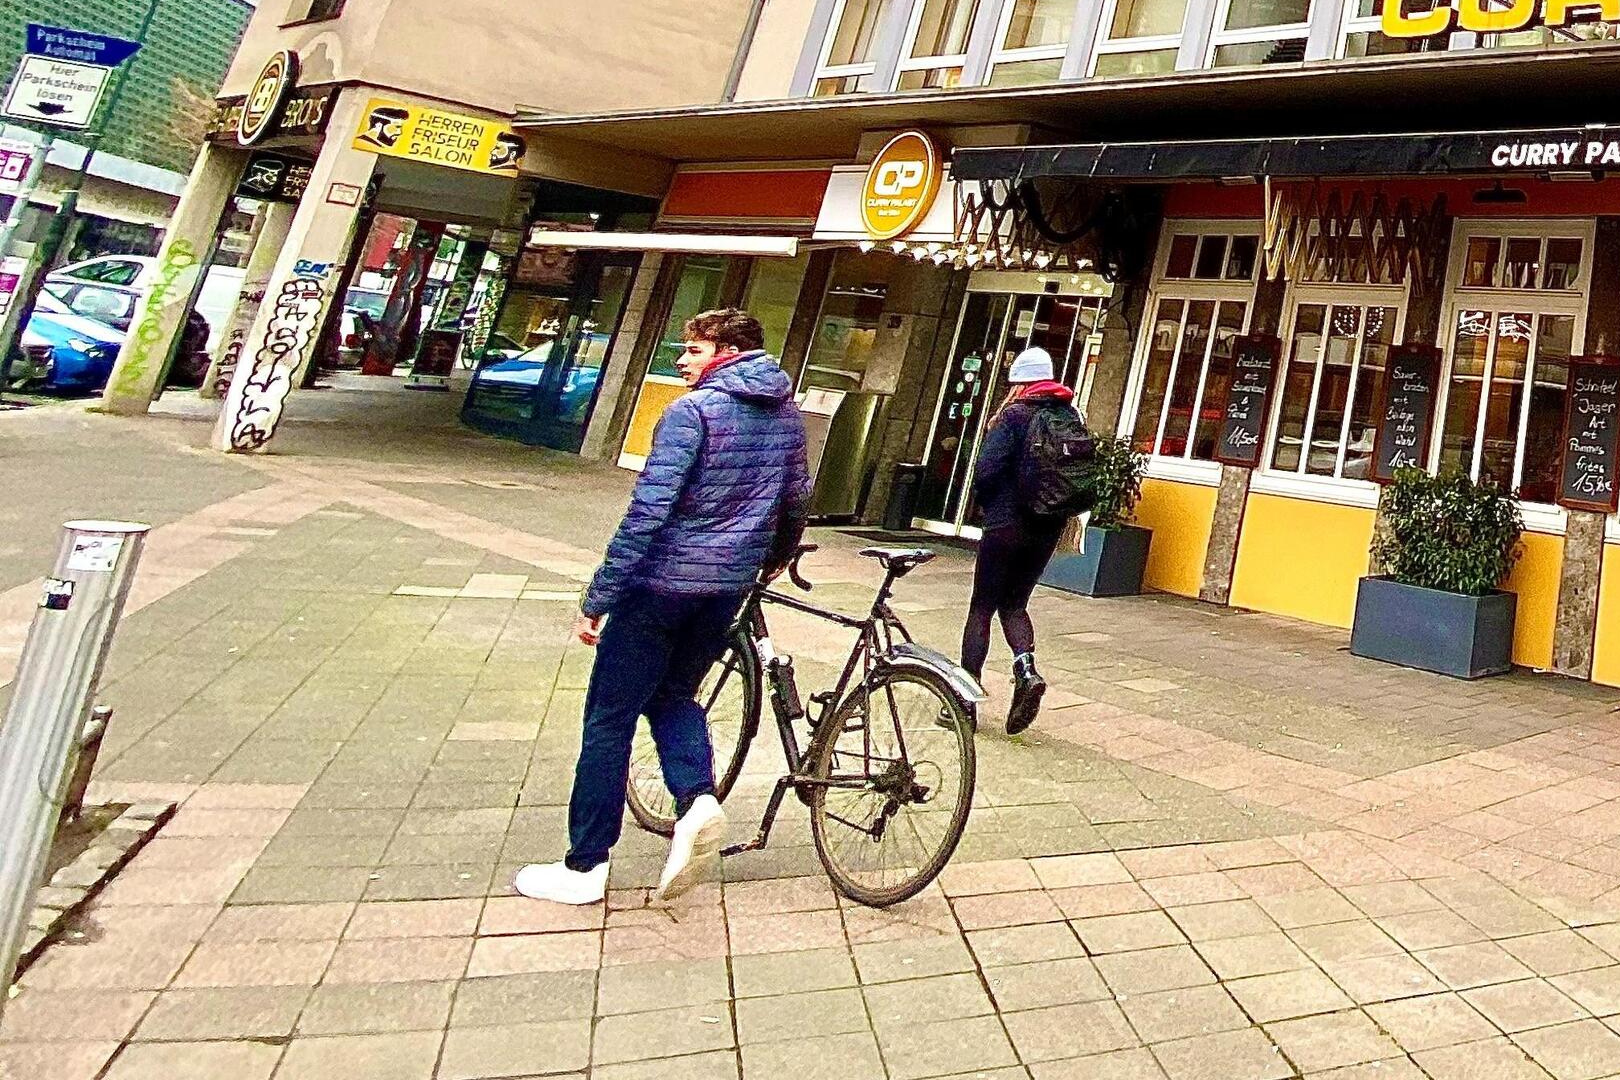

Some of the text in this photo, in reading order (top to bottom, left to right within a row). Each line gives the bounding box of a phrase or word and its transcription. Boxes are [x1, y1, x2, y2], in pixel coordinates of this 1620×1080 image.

[37, 28, 105, 50] Parkschein
[50, 65, 80, 77] Hier
[22, 73, 97, 93] Parkschein
[36, 88, 73, 101] lösen
[418, 113, 484, 137] HERREN
[411, 127, 480, 151] FRISEUR
[408, 143, 473, 165] SALON
[1491, 141, 1579, 167] CURRY
